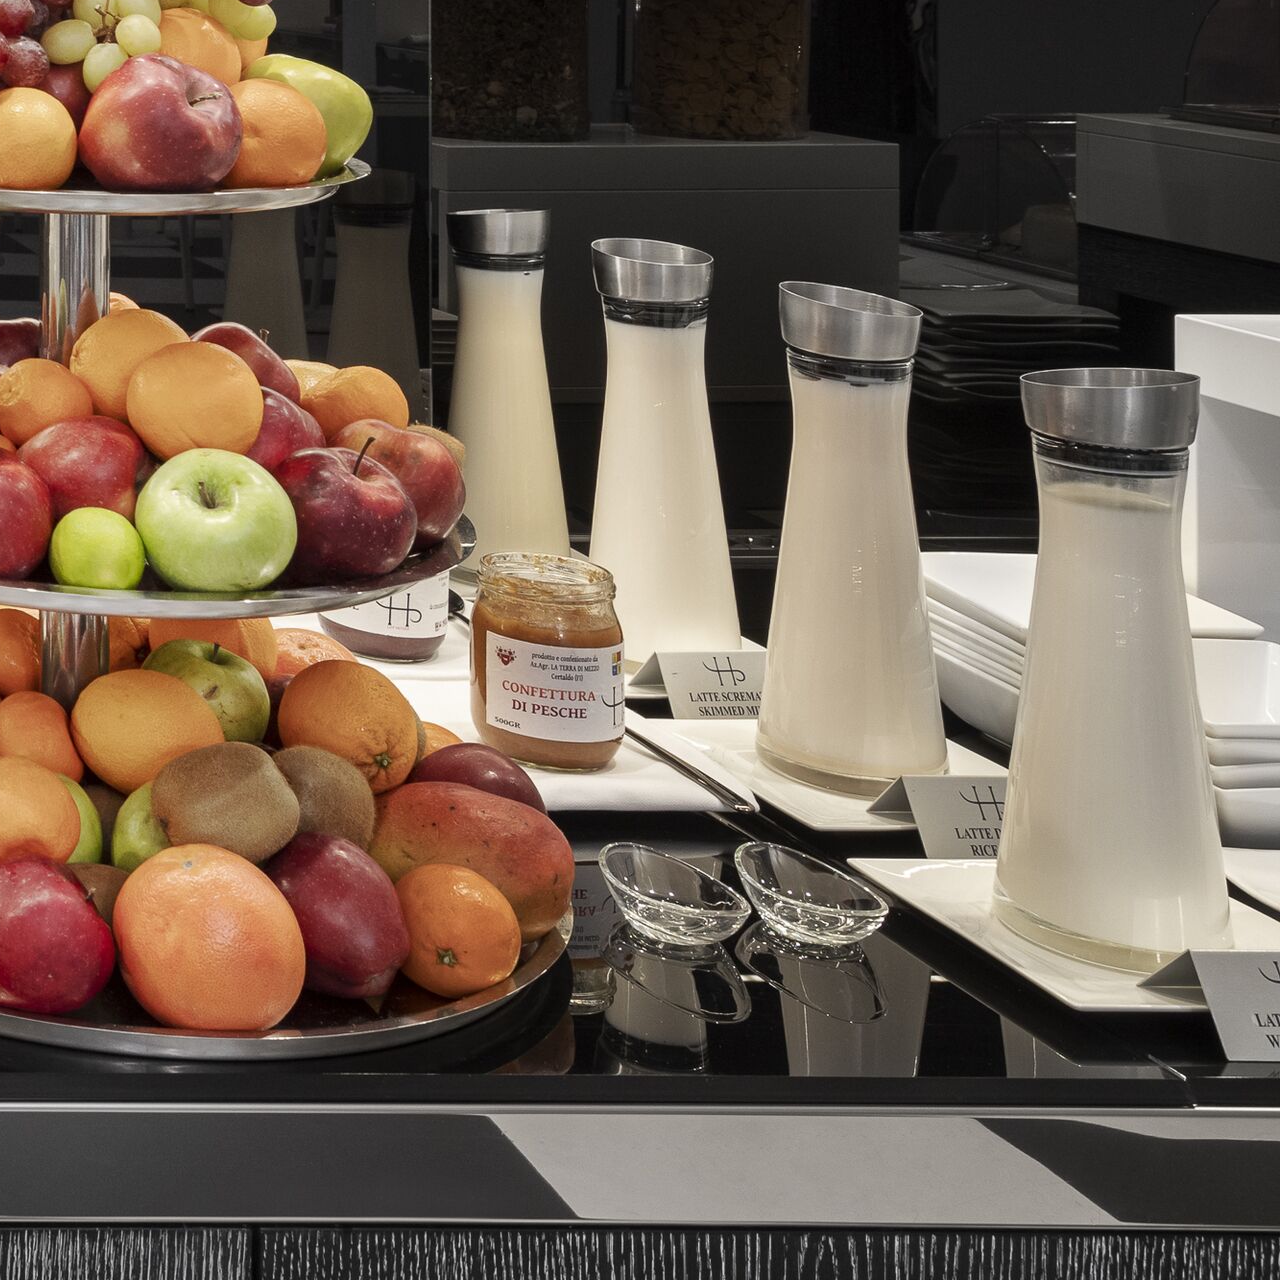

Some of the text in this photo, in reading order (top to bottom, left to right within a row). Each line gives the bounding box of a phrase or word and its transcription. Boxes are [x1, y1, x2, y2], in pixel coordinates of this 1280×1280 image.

[531, 652, 555, 661] prodotto
[551, 673, 574, 681] Certaldo
[502, 680, 596, 701] CONFETTURA
[689, 692, 761, 702] LATTE SCREMA
[512, 699, 587, 719] DI PESCHE
[698, 706, 745, 716] SKIMMED
[495, 716, 521, 729] 500GR
[954, 827, 993, 840] LATTE
[970, 844, 998, 857] RICE
[1254, 1013, 1280, 1028] LAT
